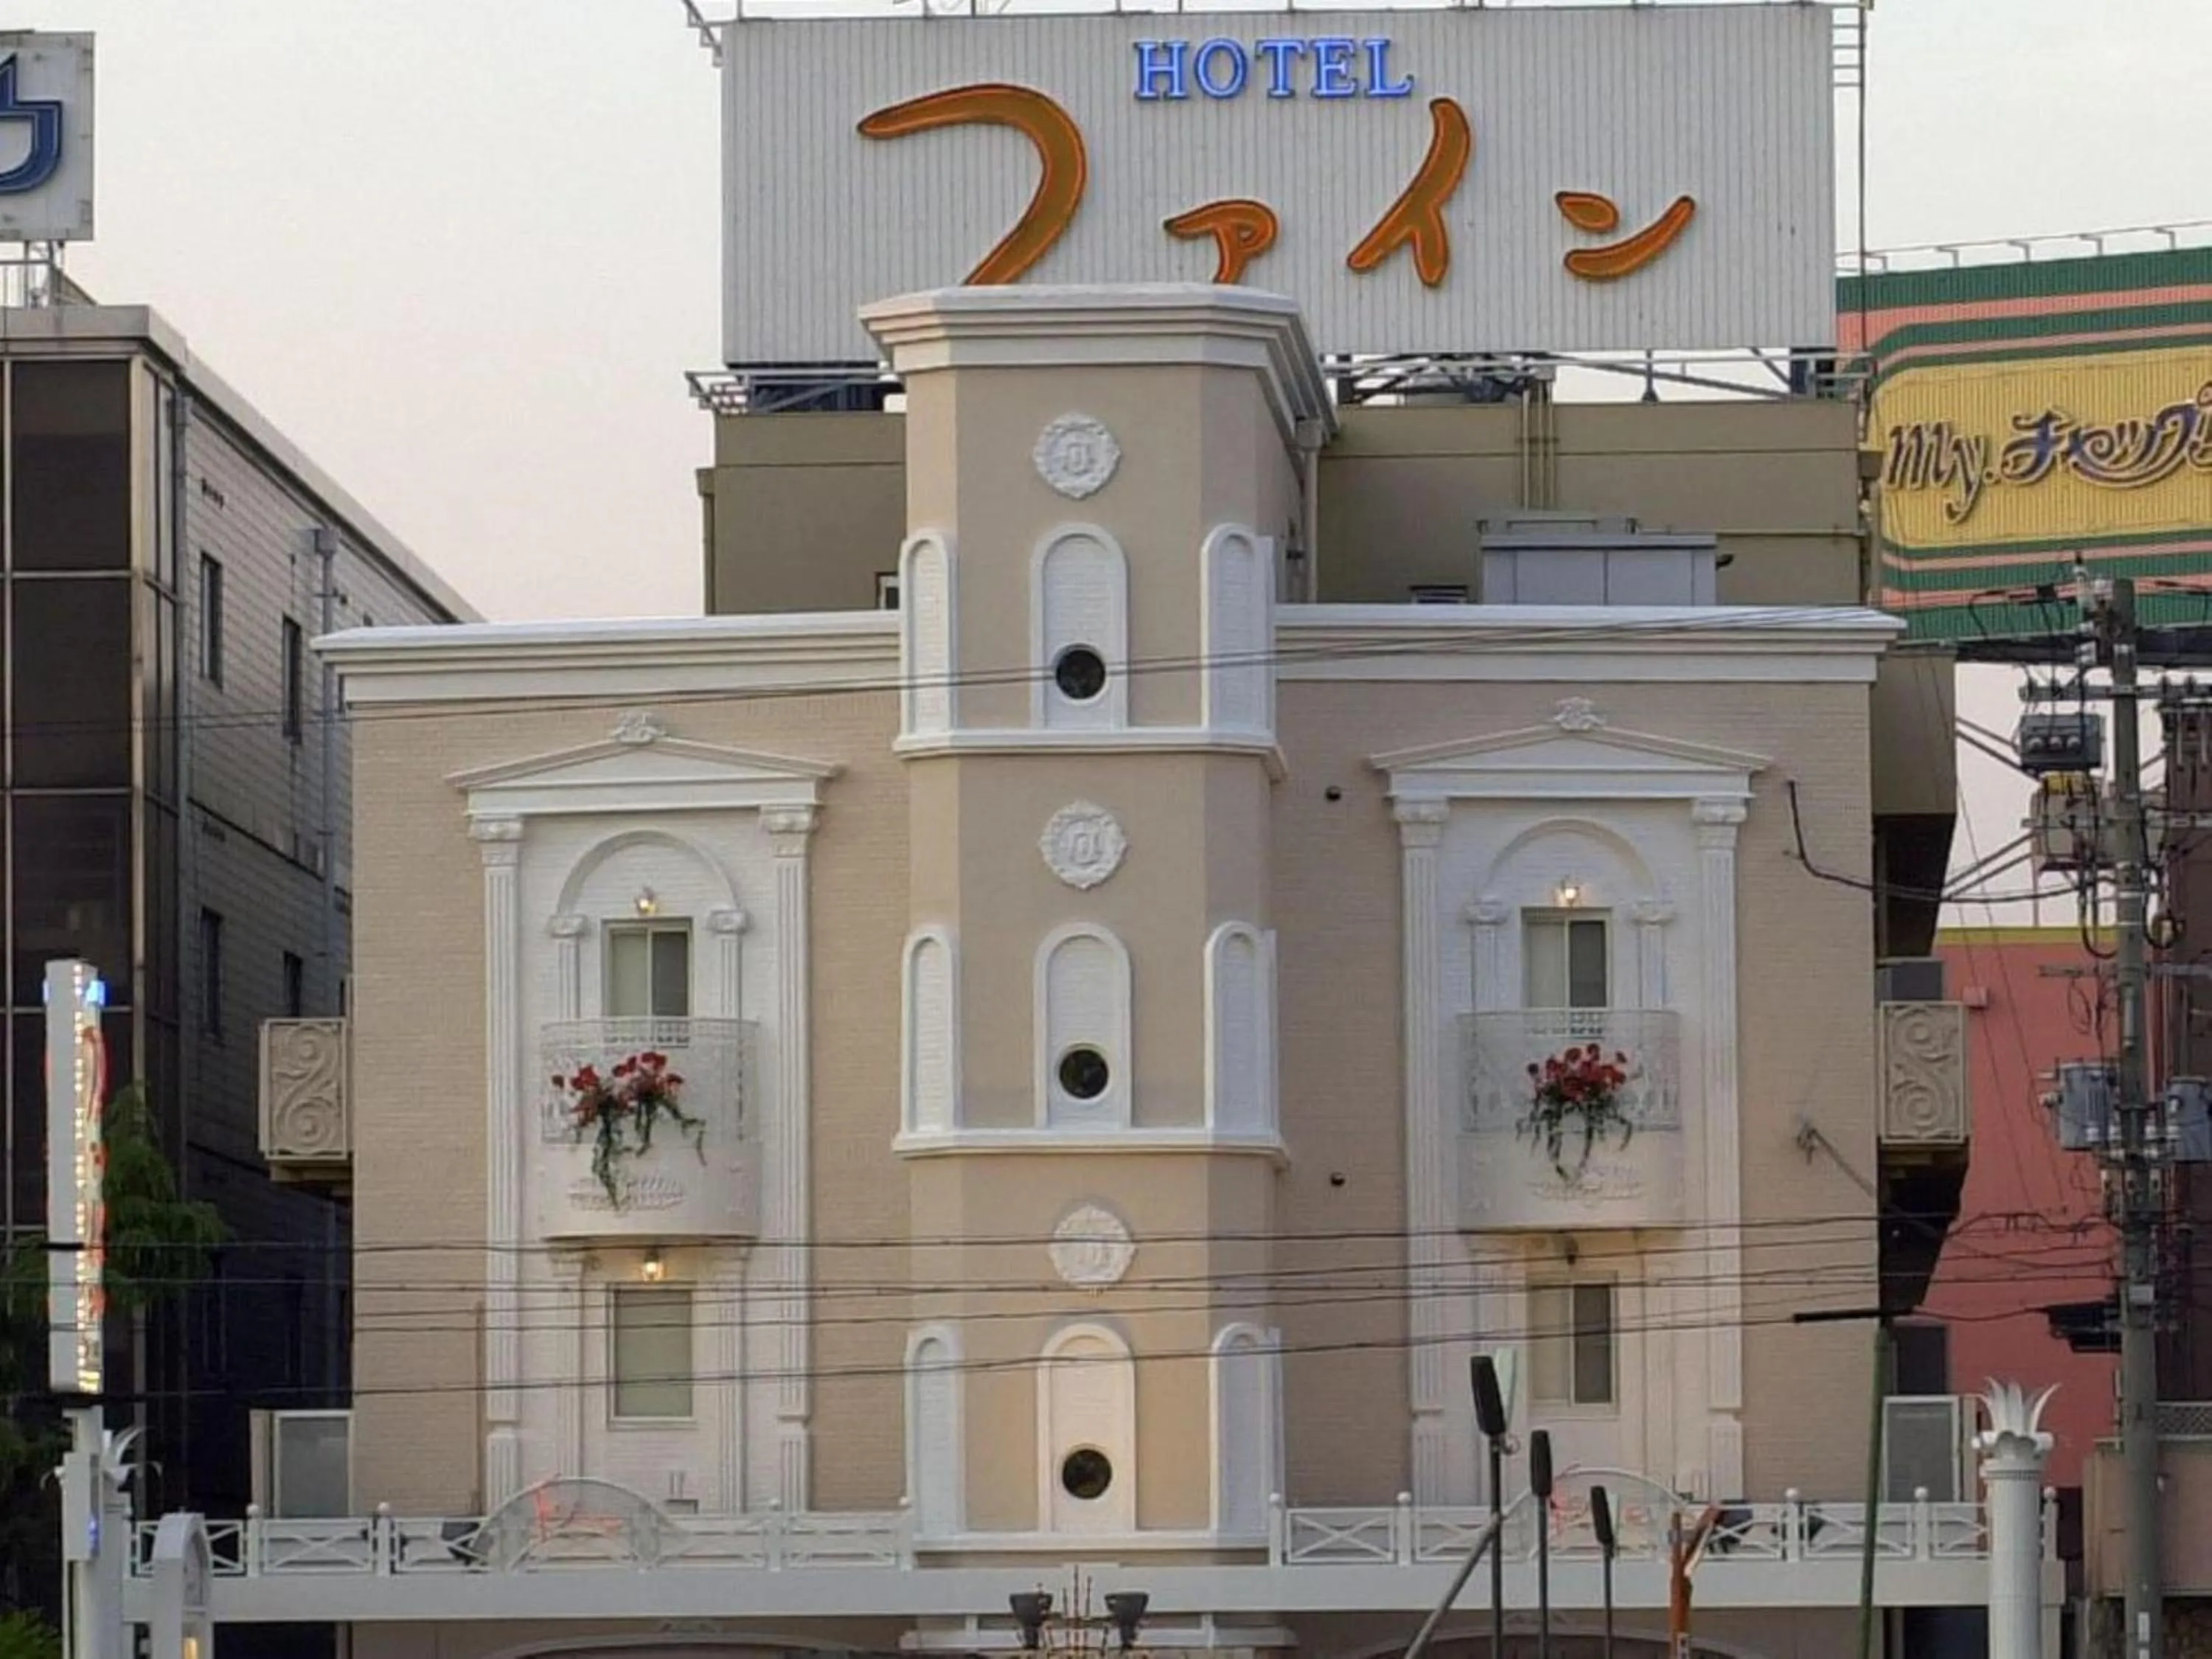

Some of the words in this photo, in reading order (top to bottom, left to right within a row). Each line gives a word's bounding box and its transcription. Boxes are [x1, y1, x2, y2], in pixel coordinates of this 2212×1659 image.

[1134, 38, 1414, 100] HOTEL
[856, 83, 1695, 288] ファイン
